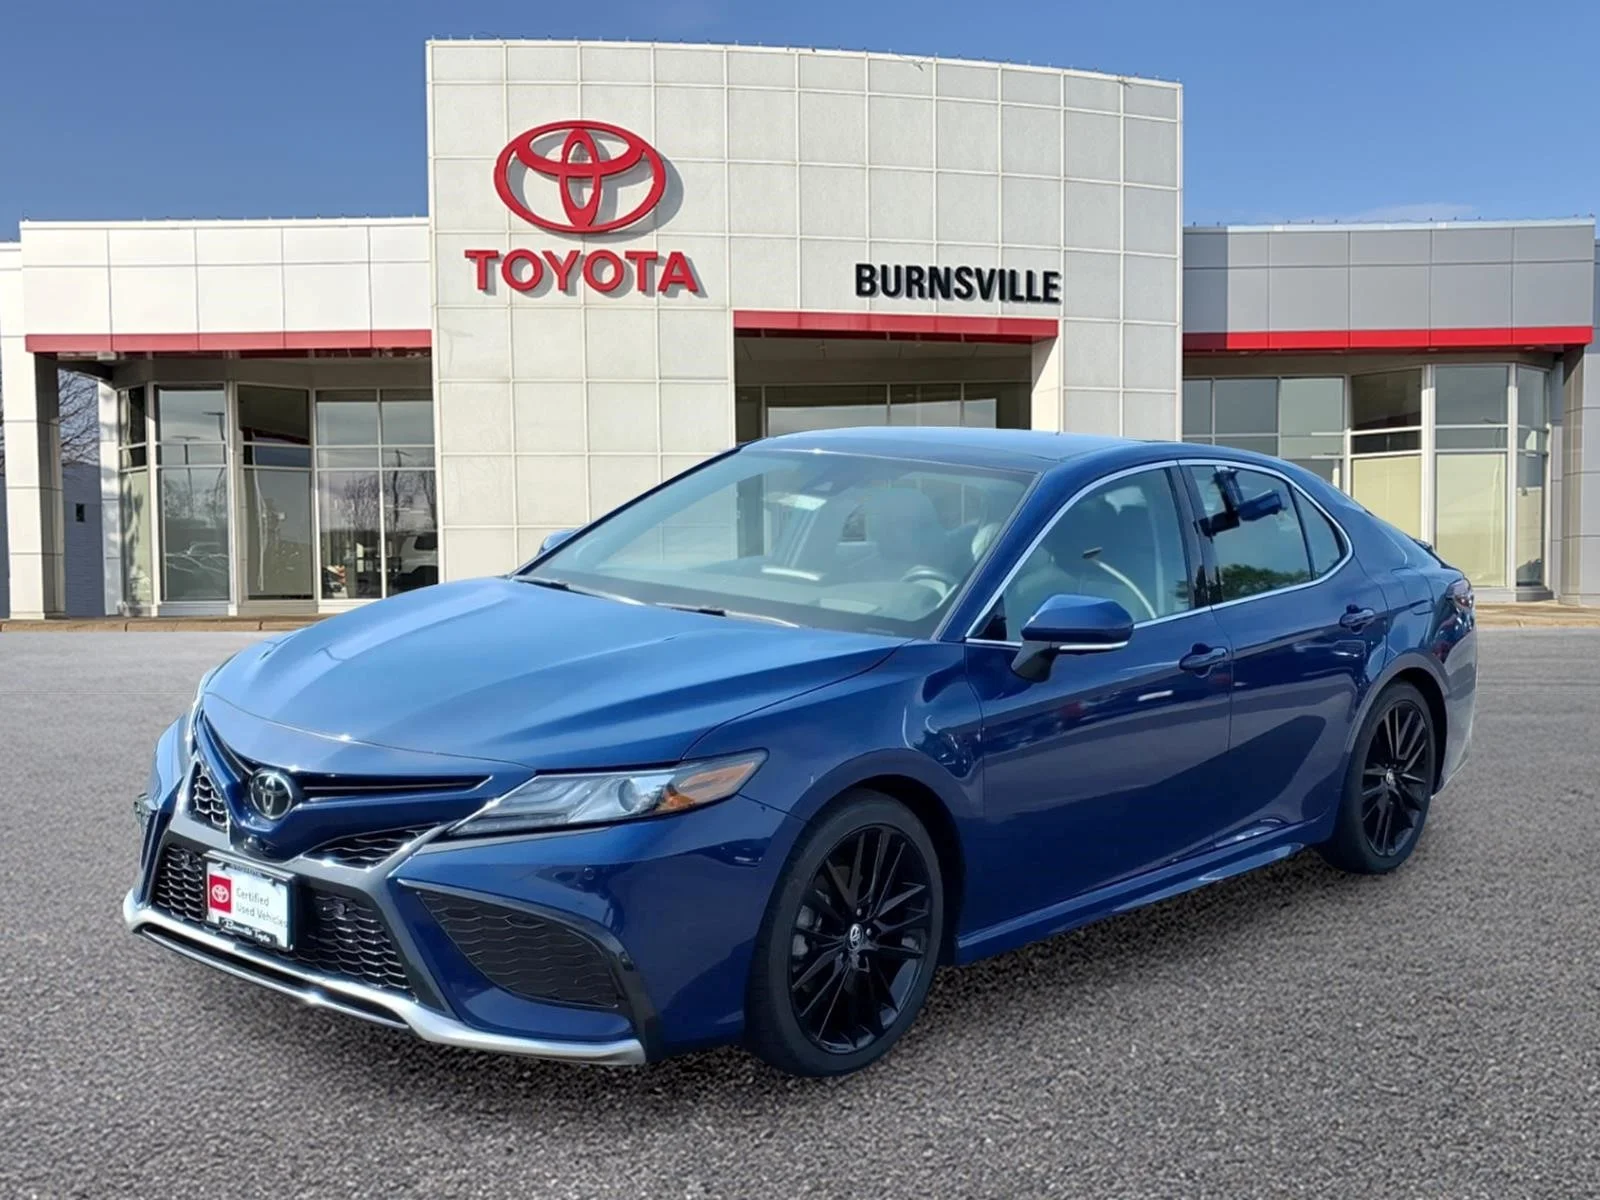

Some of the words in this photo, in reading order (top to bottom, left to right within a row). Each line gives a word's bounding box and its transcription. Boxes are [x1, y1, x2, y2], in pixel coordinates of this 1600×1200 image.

[464, 249, 698, 292] TOYOTA
[855, 263, 1061, 303] BURNSVILLE
[236, 887, 269, 906] Certified
